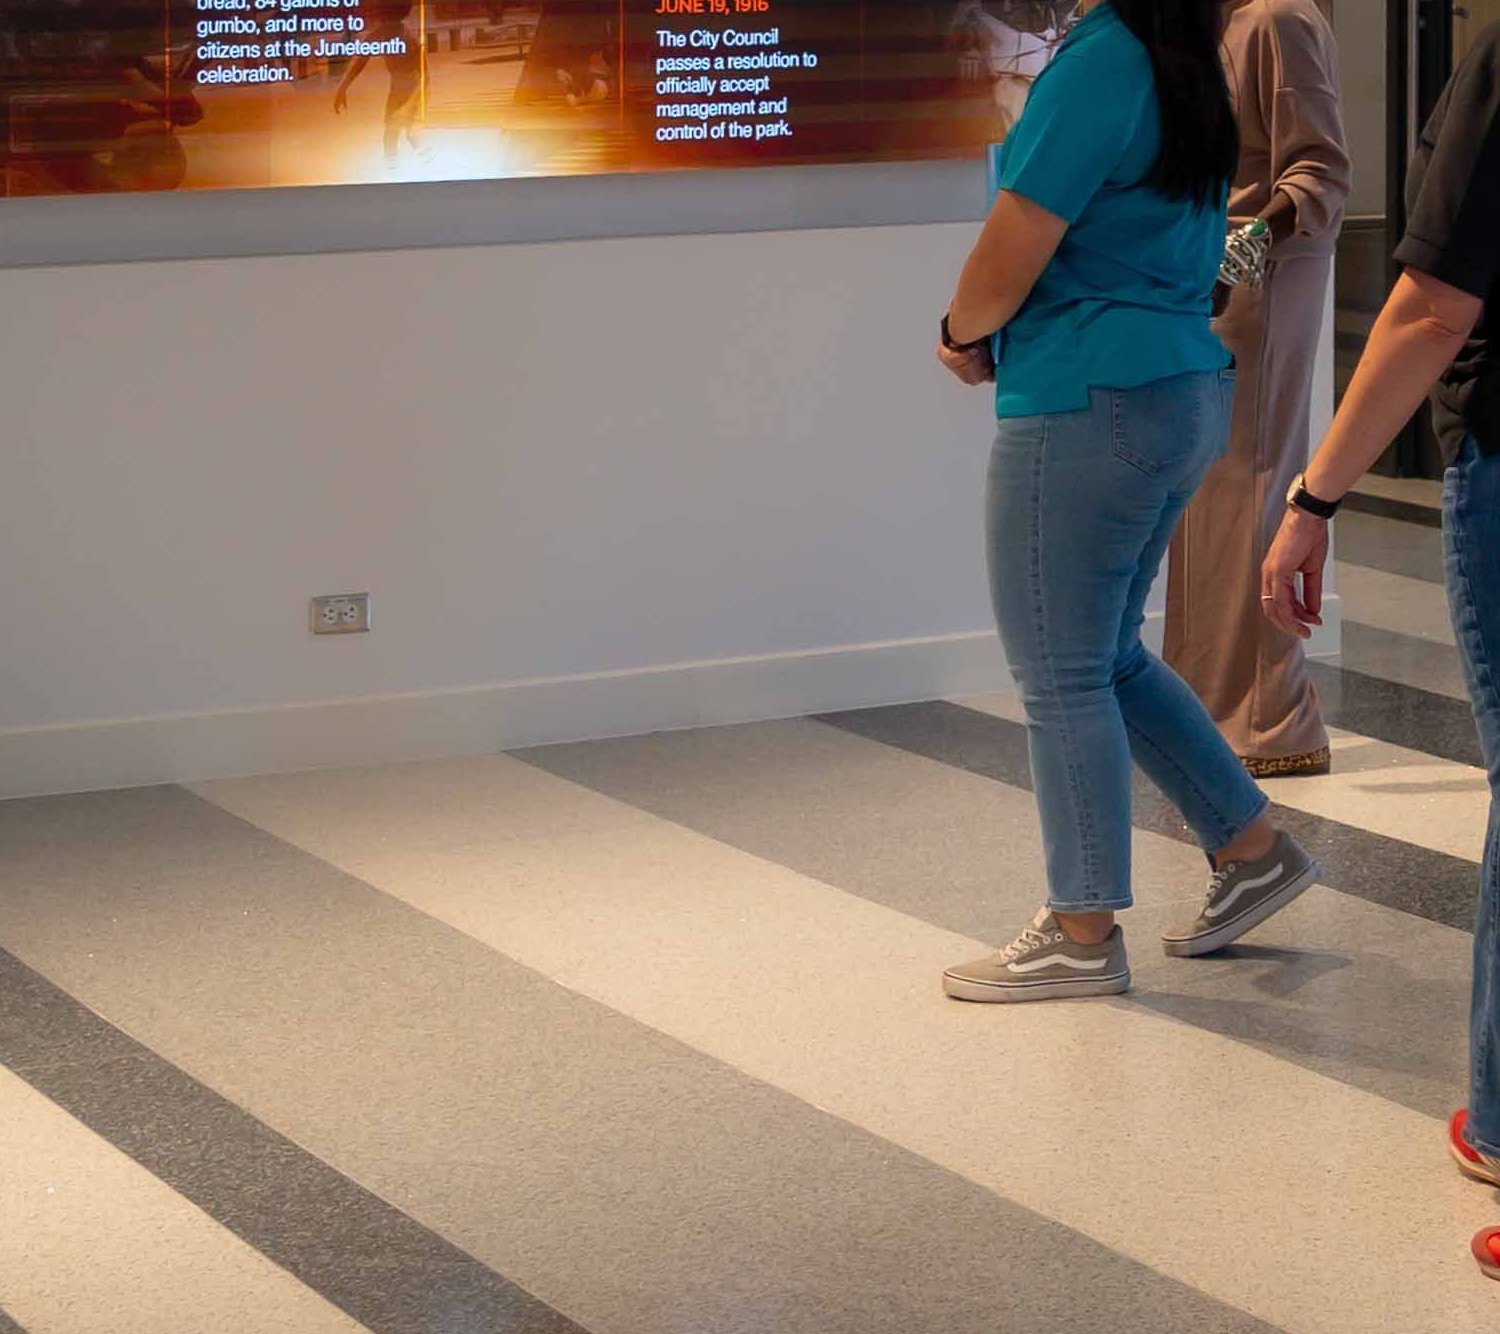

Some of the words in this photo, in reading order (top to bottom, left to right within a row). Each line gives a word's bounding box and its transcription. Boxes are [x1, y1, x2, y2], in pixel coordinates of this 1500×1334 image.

[656, 30, 687, 47] The
[689, 29, 720, 51] City
[722, 27, 779, 47] Council
[196, 63, 294, 84] celebration.
[655, 75, 717, 97] officially
[719, 75, 770, 95] accept
[656, 99, 756, 121] management
[758, 96, 788, 115] and
